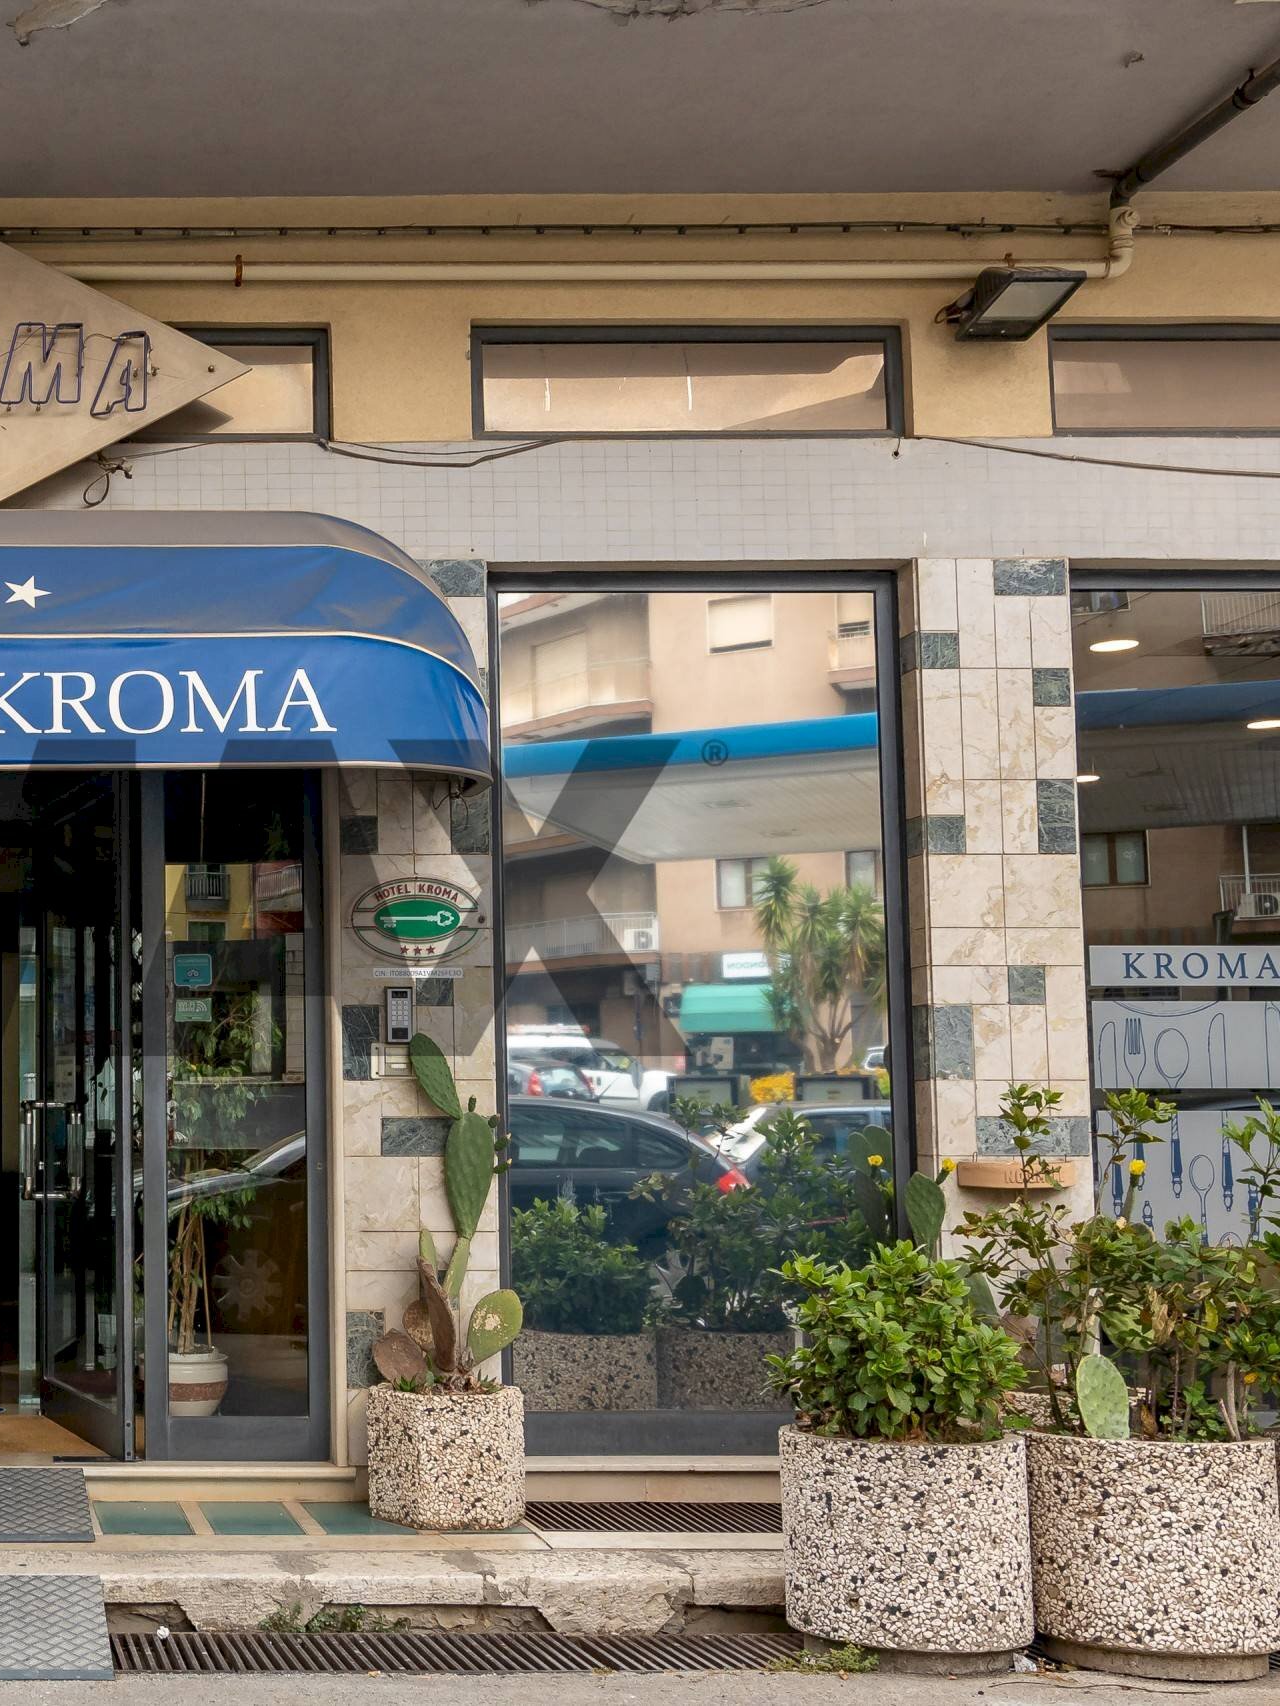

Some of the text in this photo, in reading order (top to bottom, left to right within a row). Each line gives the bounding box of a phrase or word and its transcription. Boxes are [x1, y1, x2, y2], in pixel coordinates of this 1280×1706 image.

[374, 883, 459, 903] HOTEL KROMA
[1121, 951, 1280, 980] KROMA
